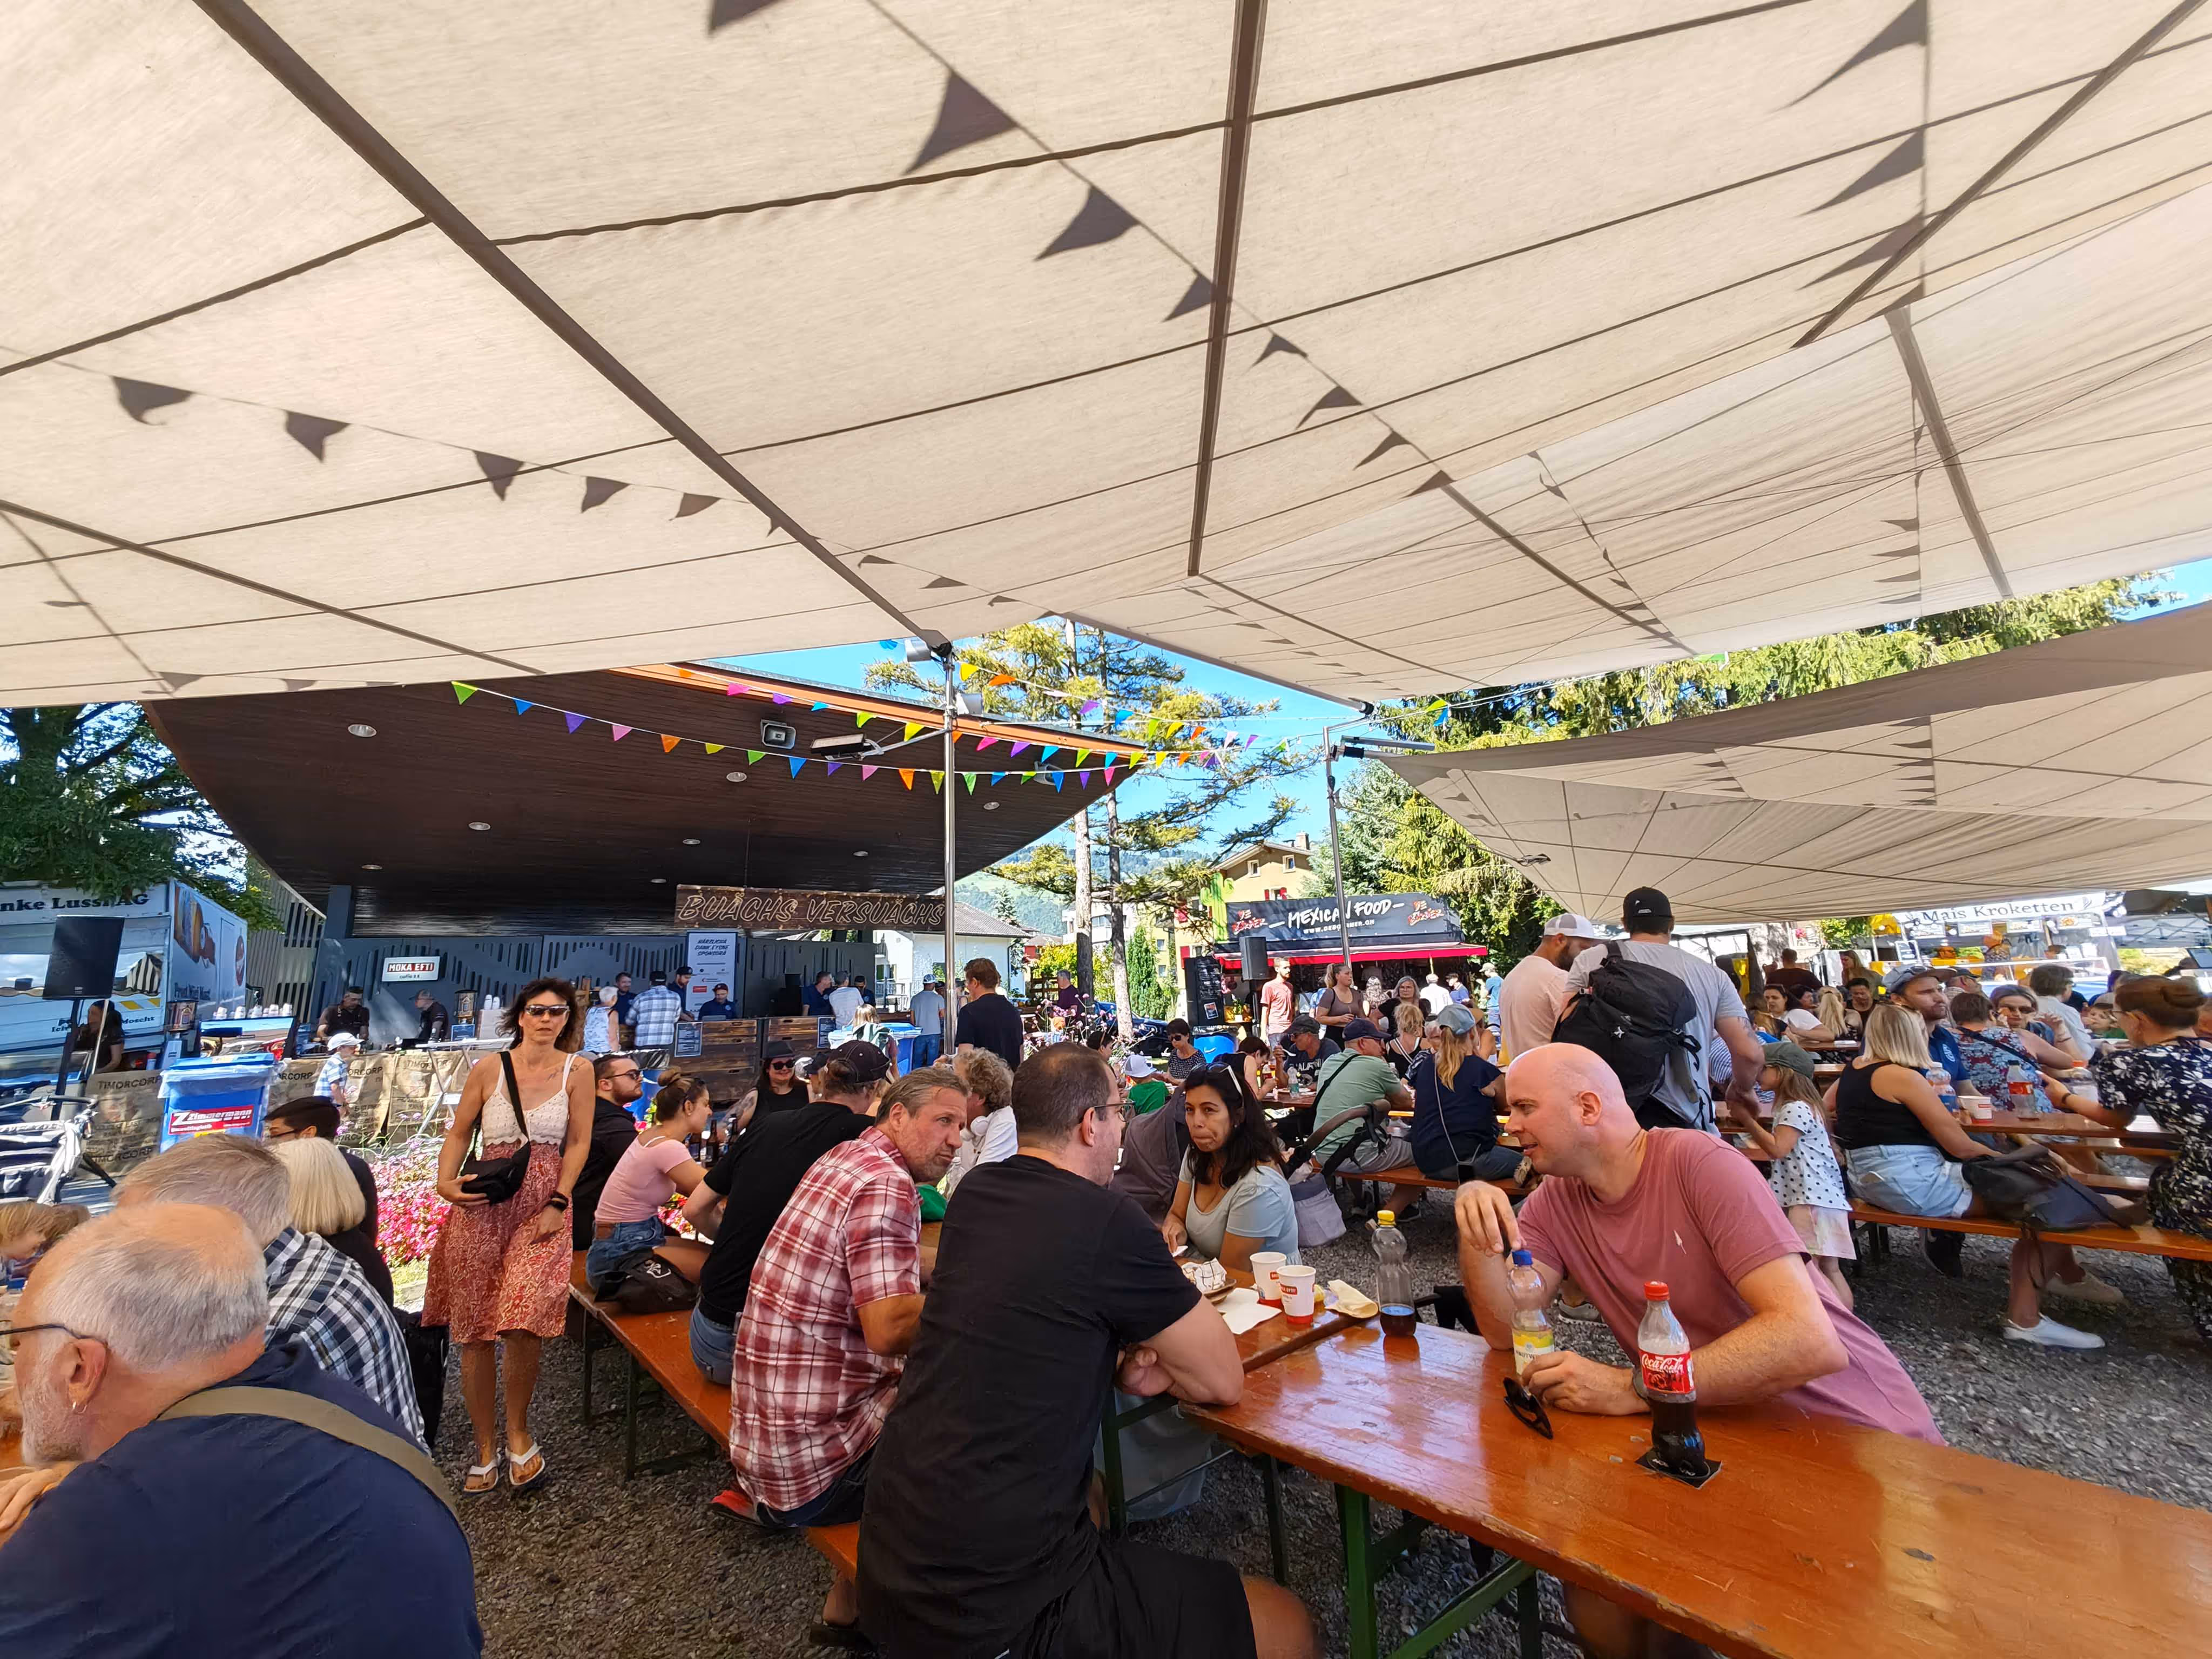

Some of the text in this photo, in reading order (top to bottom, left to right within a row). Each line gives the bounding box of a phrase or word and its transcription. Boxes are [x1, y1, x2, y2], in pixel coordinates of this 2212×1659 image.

[1354, 899, 1392, 916] FOOD
[1922, 901, 2074, 922] Mais Kroketten
[389, 963, 433, 972] MOKA EFTI
[1642, 1353, 1684, 1375] Coca-Cola
